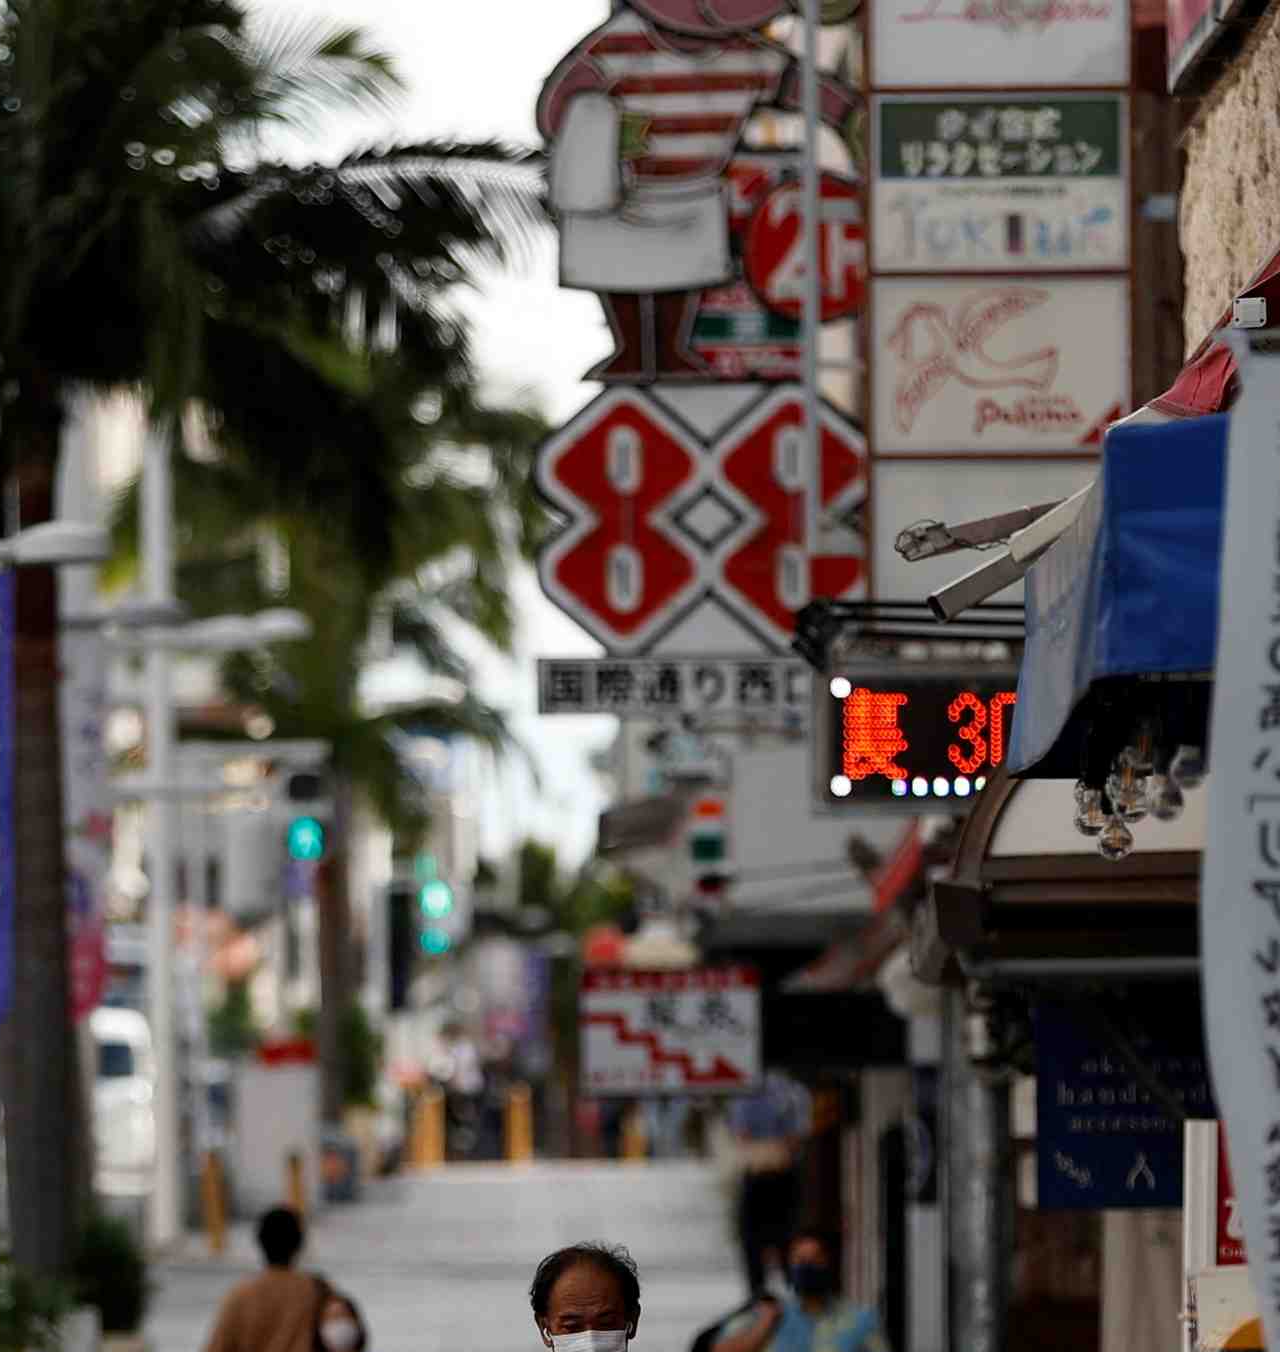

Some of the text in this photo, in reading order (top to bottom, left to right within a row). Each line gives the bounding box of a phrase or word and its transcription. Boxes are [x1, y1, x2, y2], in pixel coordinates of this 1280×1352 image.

[900, 141, 1103, 176] リラクゼーション
[767, 188, 866, 299] 2F
